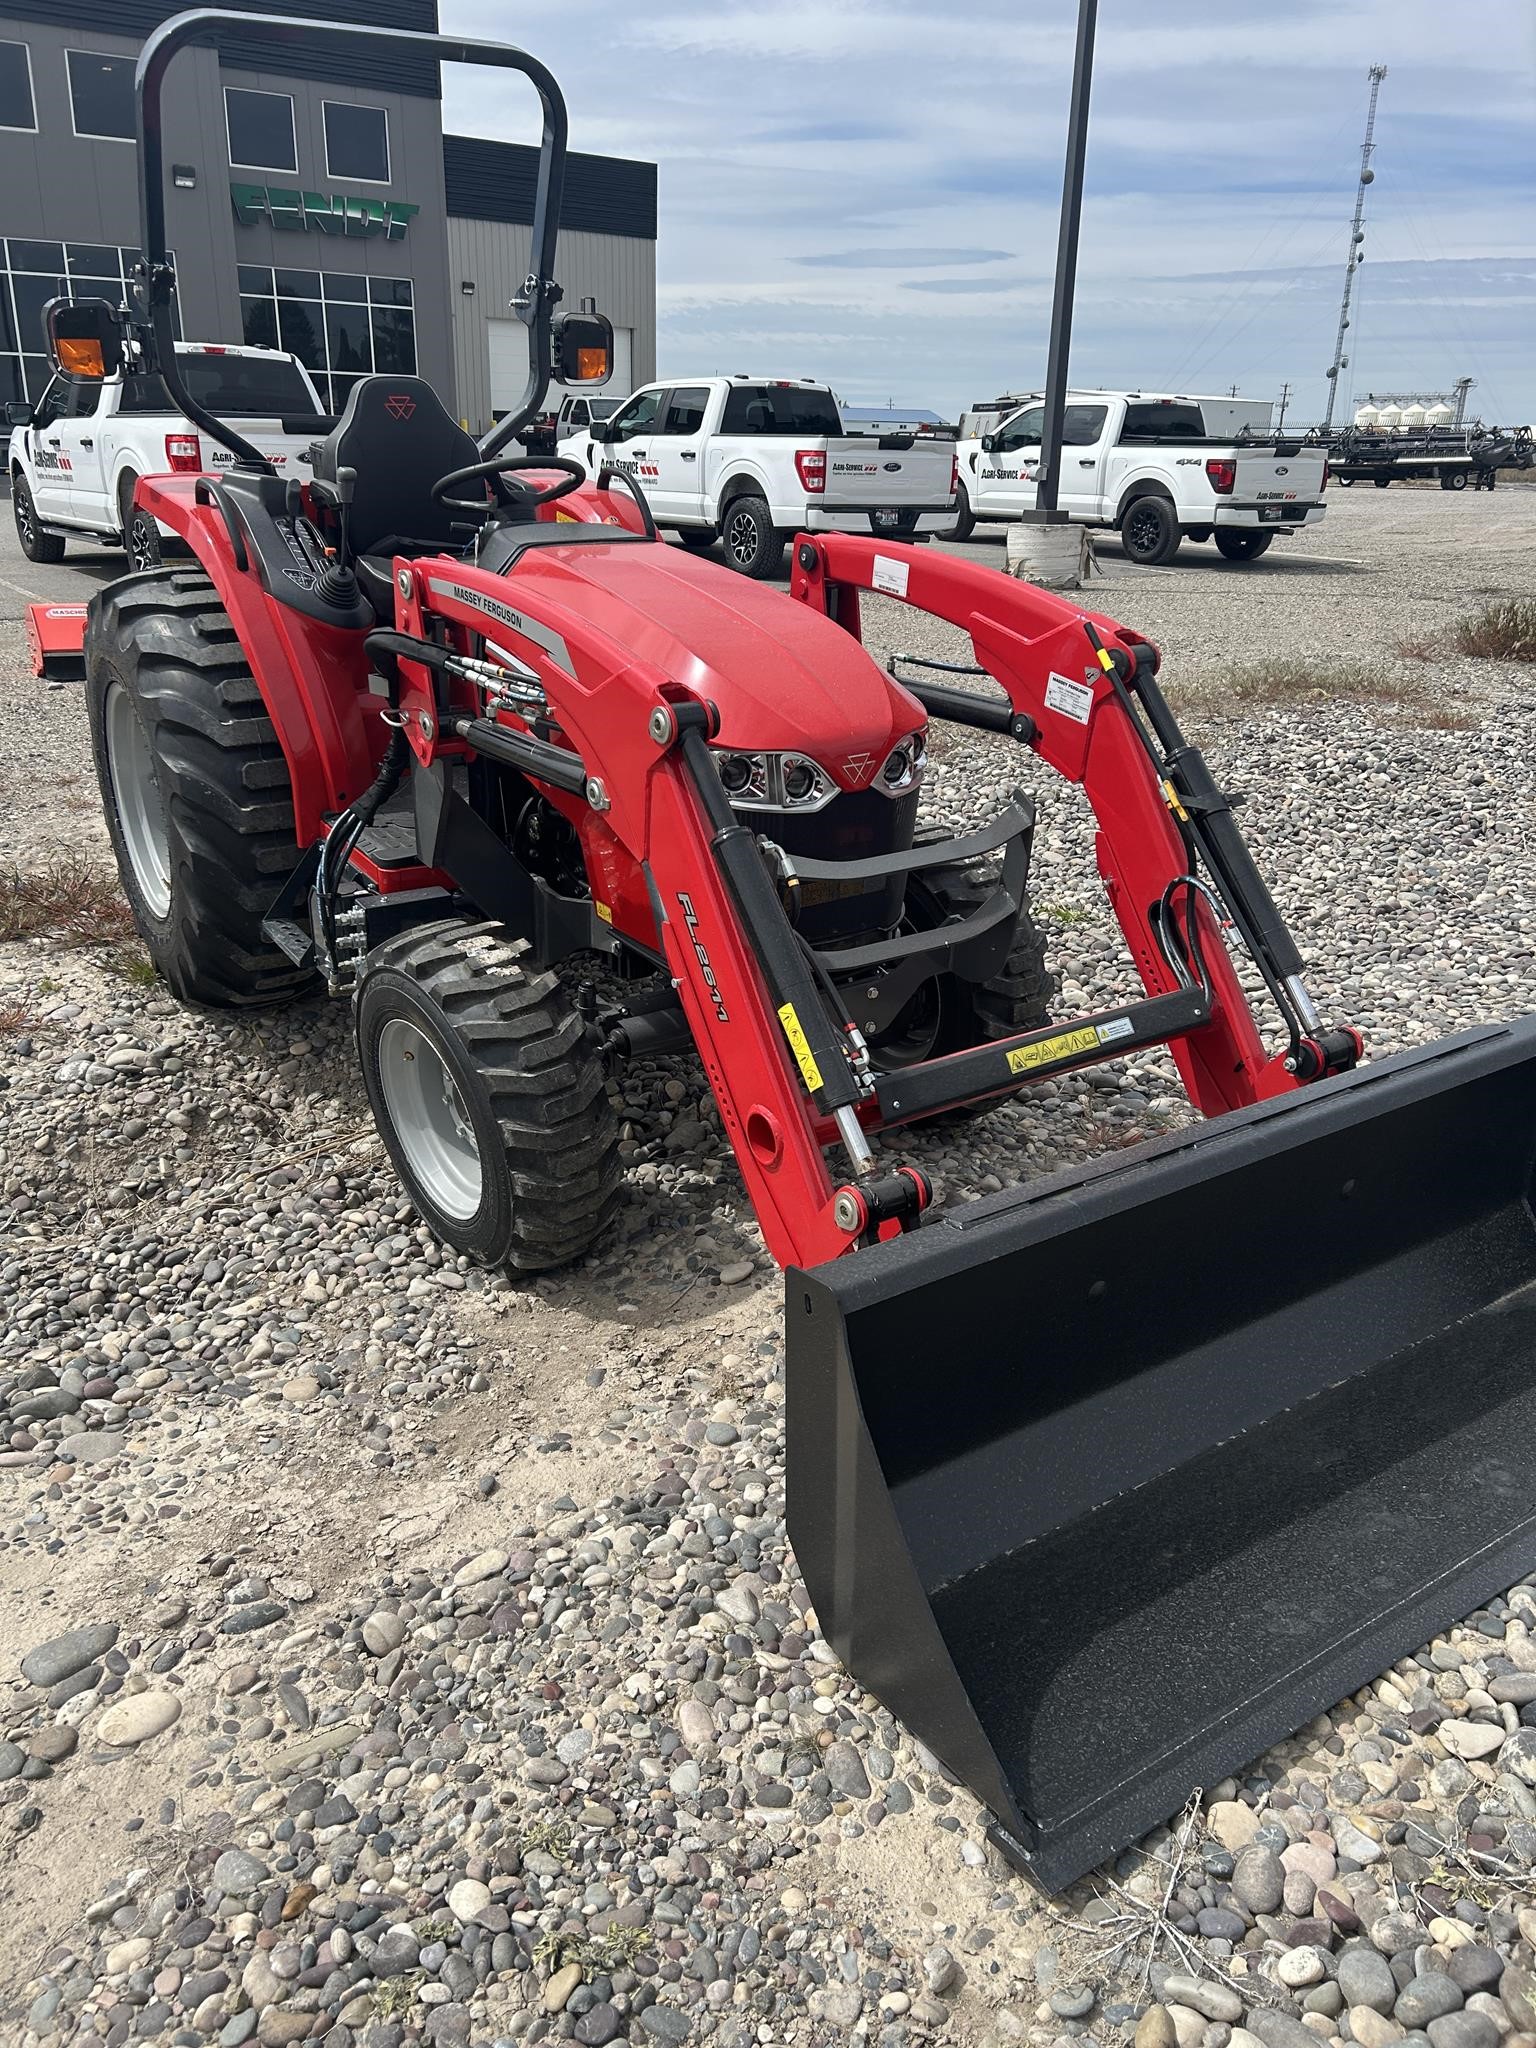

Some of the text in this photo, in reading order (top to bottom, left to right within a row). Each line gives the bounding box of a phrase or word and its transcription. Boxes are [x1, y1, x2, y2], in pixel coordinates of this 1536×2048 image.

[230, 183, 420, 241] FENDT
[832, 463, 864, 471] AGRI-SERVICE
[981, 469, 1019, 479] AGRI-SERVICE
[453, 586, 522, 629] MASSEY FERGUSON
